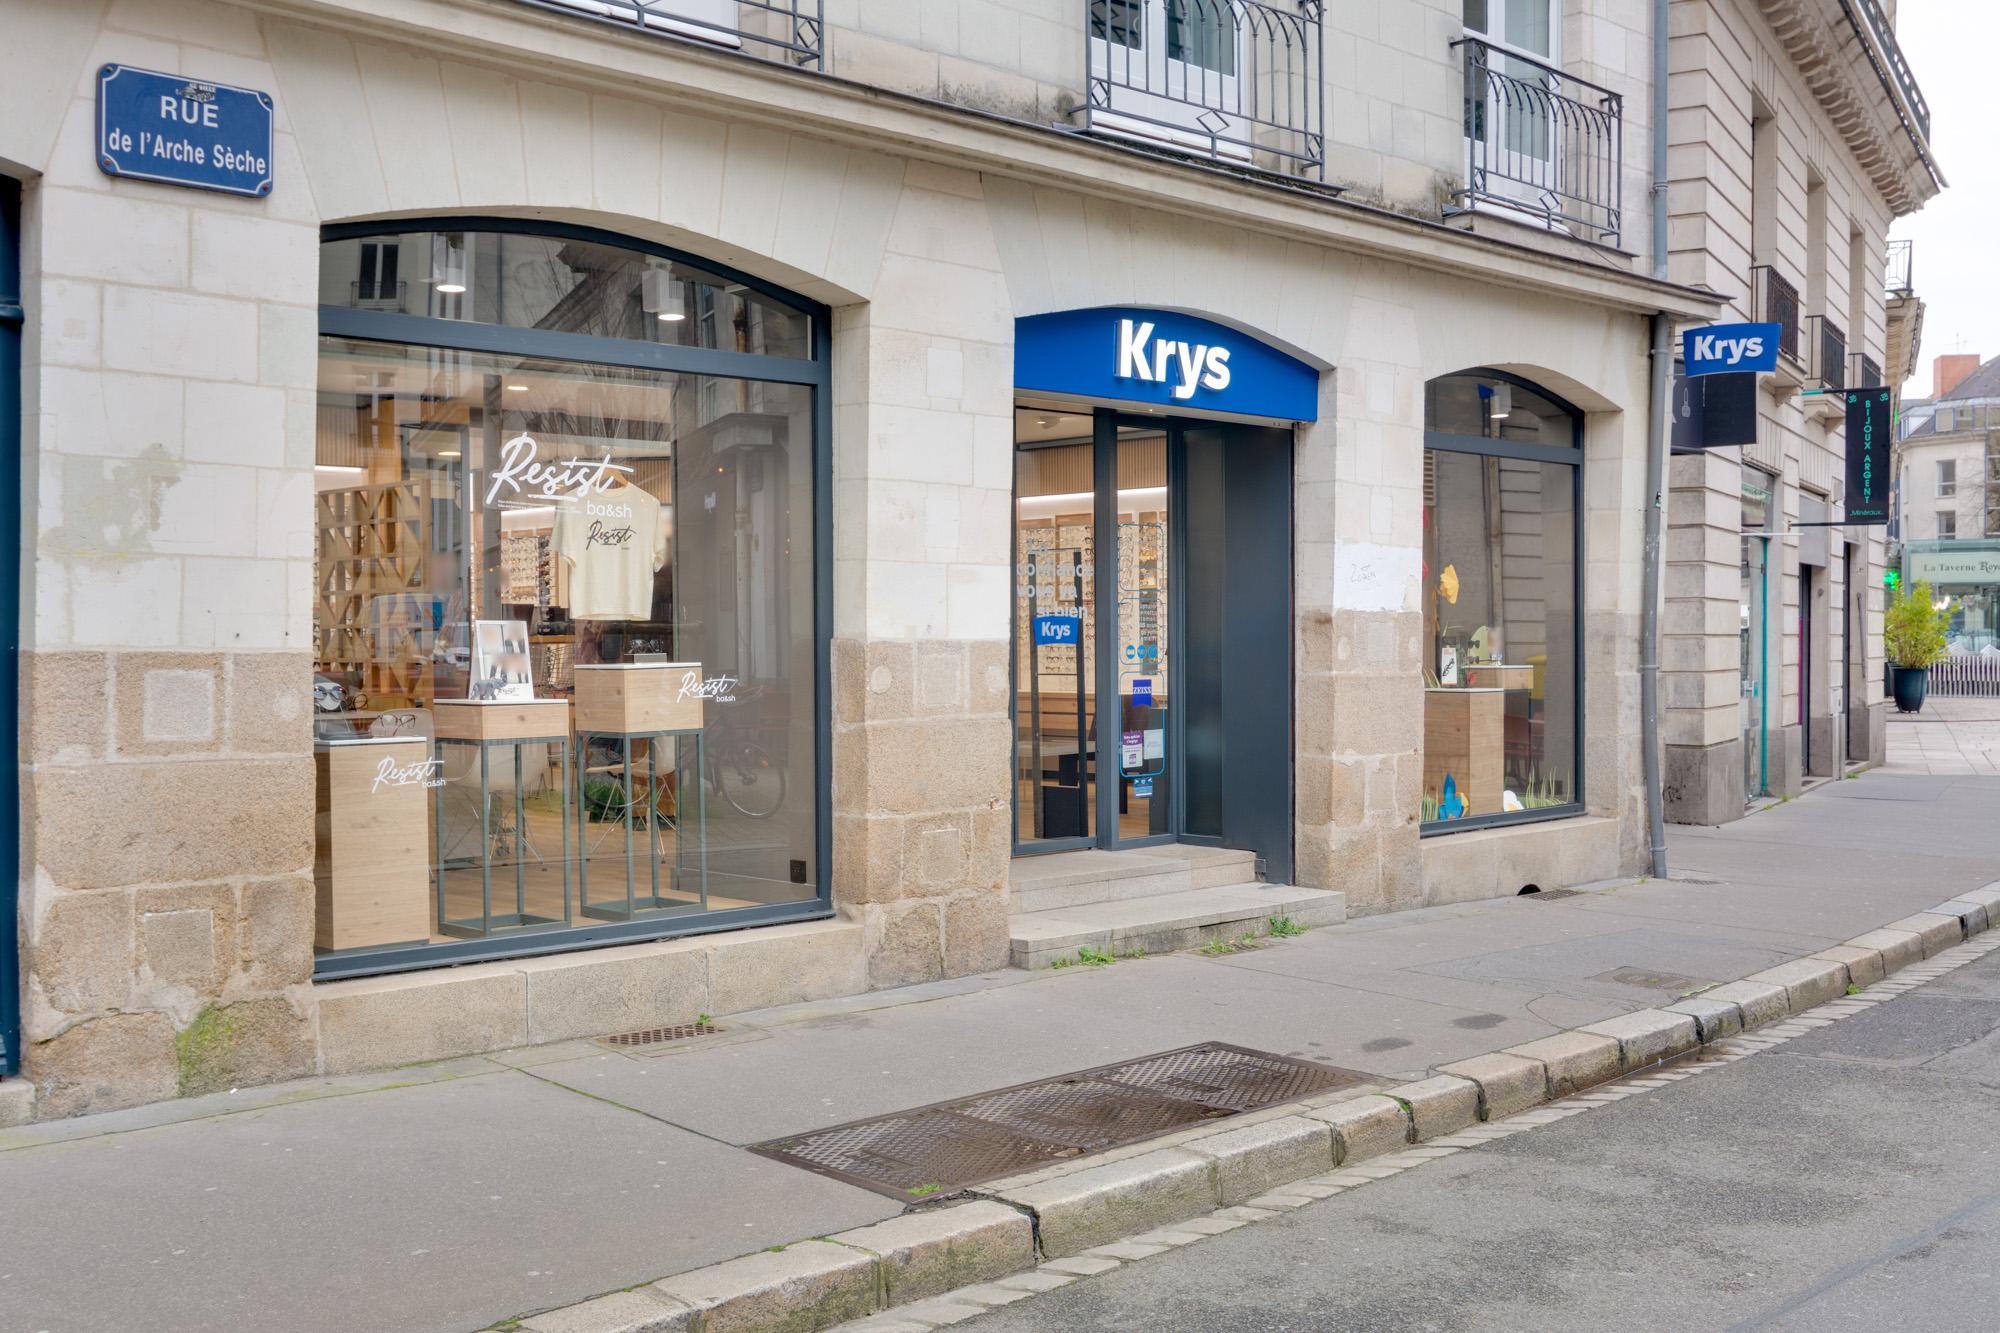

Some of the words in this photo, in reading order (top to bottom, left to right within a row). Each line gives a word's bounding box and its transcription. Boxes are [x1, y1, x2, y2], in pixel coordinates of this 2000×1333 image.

[160, 95, 219, 128] RUE
[108, 127, 132, 152] de
[213, 144, 266, 175] Sèche
[1114, 318, 1231, 399] Krys
[1693, 334, 1764, 365] Krys
[1863, 400, 1872, 449] BIJOUX
[485, 431, 634, 505] Resist
[1863, 454, 1872, 504] ARGENT
[586, 500, 632, 519] ba&sh
[585, 519, 637, 551] Resist
[1041, 621, 1071, 640] Krys
[676, 670, 737, 703] Resist
[371, 755, 445, 794] Resist
